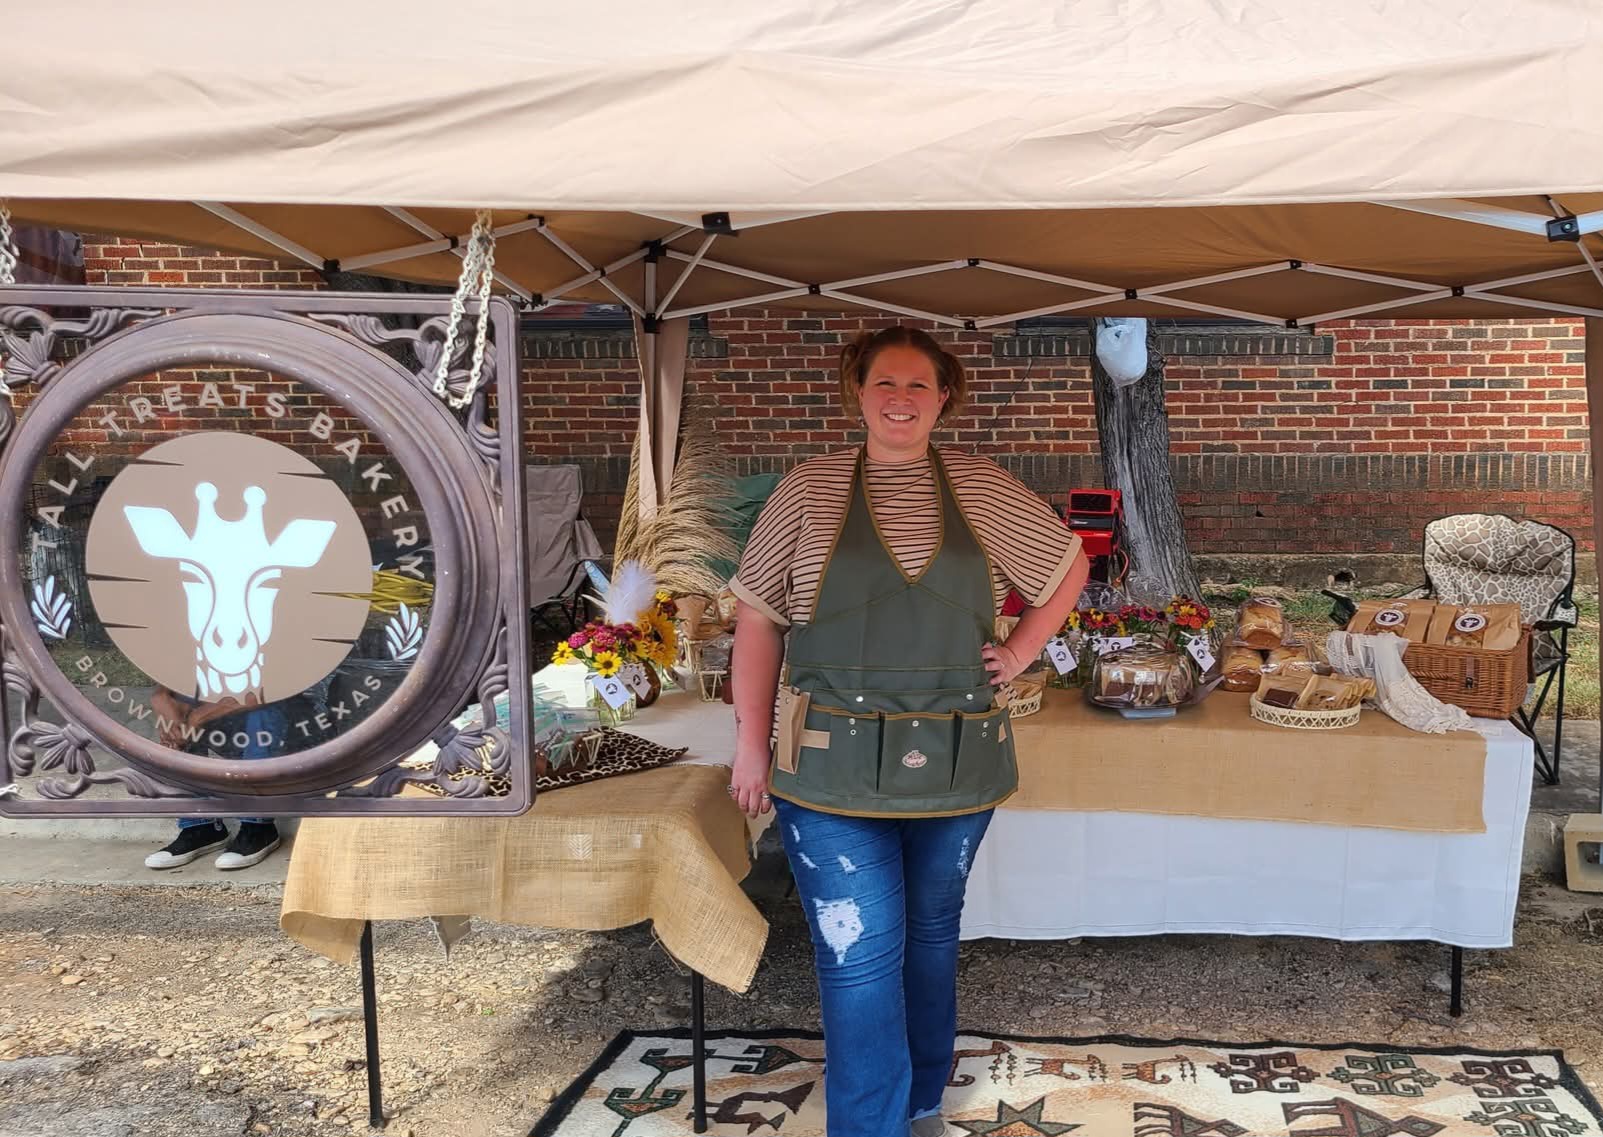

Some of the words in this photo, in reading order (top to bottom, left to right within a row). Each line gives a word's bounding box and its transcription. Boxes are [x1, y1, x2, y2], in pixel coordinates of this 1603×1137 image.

[32, 451, 95, 552] TALL
[98, 383, 288, 438] TREATS
[309, 411, 425, 579] BAKERY
[75, 655, 286, 748] BROWNWOOD,
[295, 675, 382, 738] TEXAS
